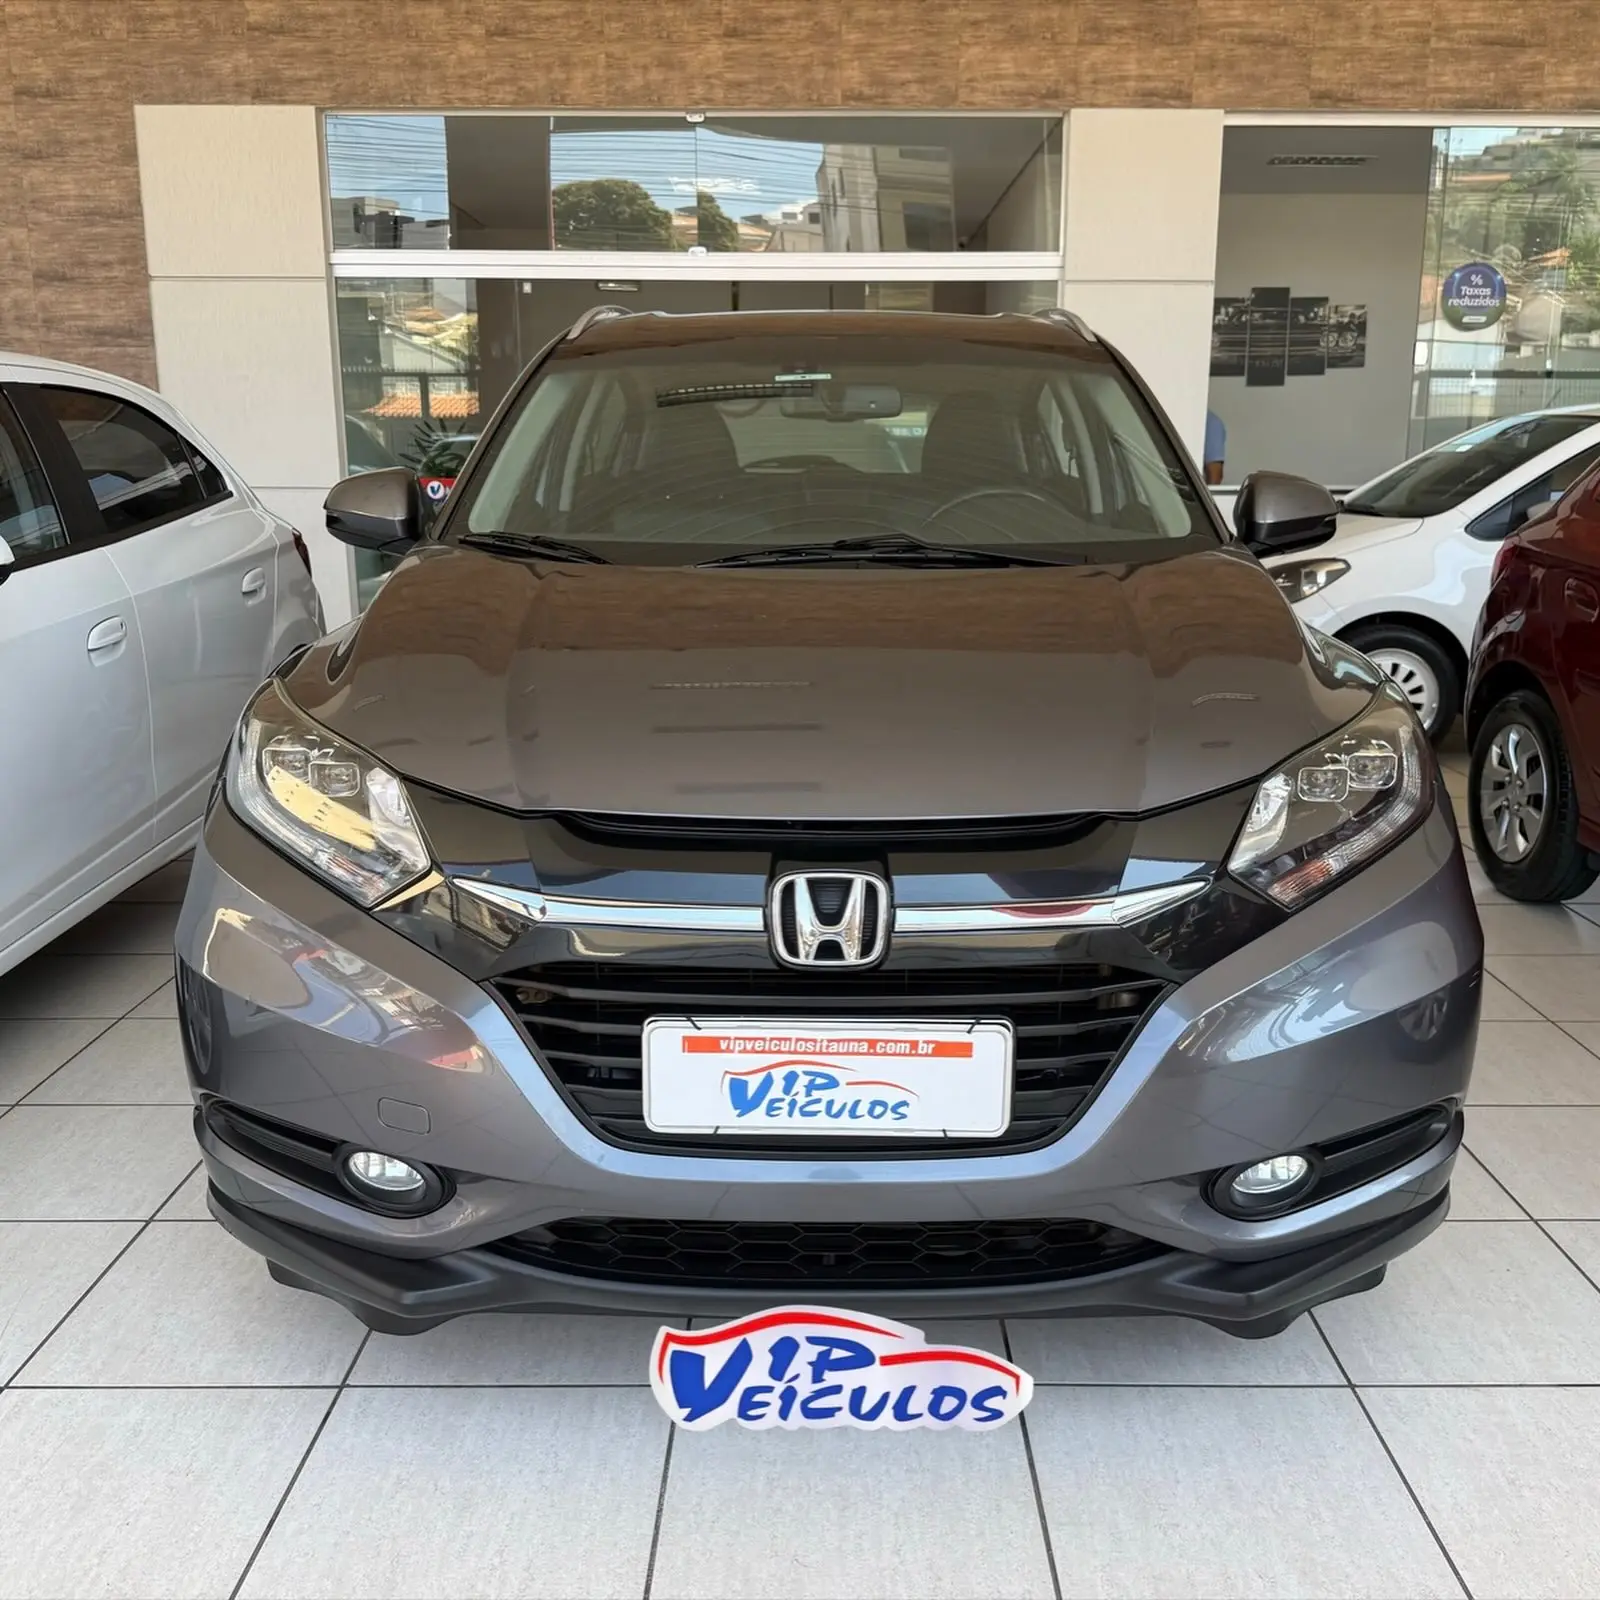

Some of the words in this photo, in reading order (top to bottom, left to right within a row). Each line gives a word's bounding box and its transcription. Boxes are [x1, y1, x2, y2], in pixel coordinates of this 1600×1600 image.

[1460, 286, 1492, 296] Taxas
[719, 1036, 936, 1057] vipveiculositauna.com.br
[729, 1070, 840, 1118] VIP
[670, 1335, 876, 1422] VIP
